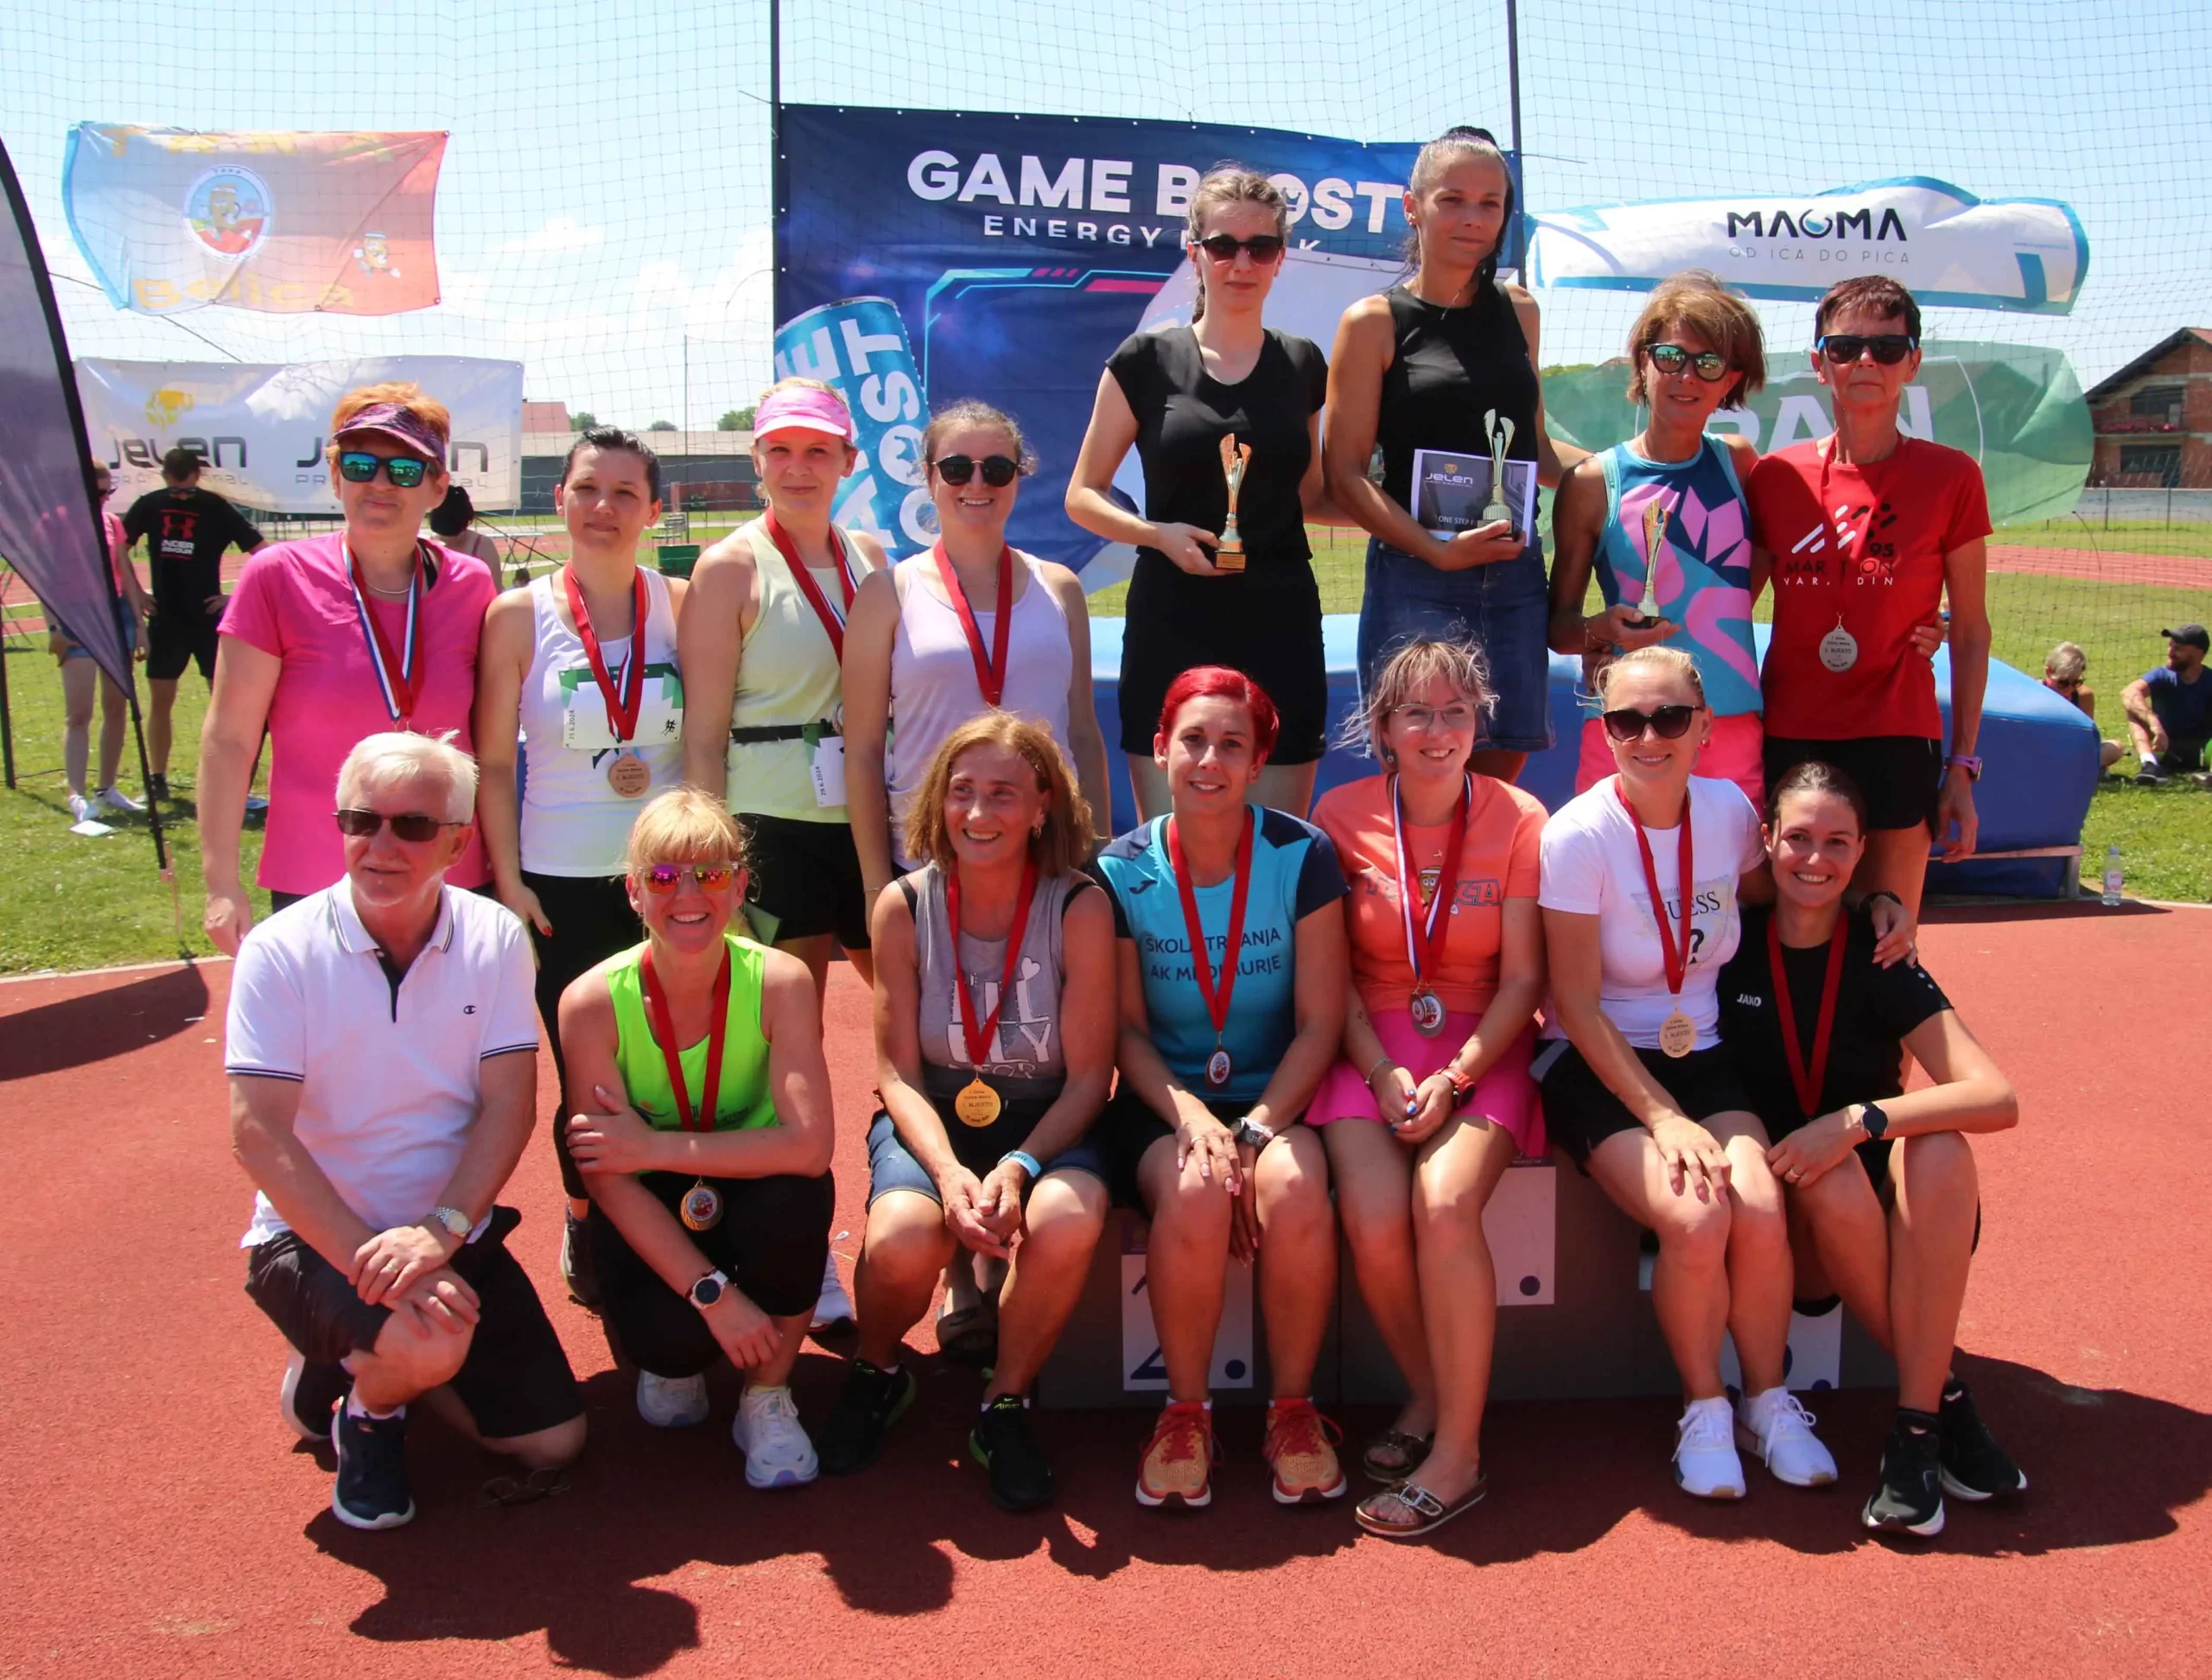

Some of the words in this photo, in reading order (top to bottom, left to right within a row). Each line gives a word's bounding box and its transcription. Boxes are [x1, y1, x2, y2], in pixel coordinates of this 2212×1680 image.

[907, 150, 1134, 214] GAME
[1156, 162, 1404, 234] BOST
[983, 214, 1163, 249] ENERGY
[1726, 207, 1908, 241] MAGMA
[1729, 246, 1758, 259] OD
[1819, 248, 1848, 263] DO
[1438, 515, 1453, 524] ONE
[1869, 542, 1895, 558] 95
[1785, 559, 1895, 576] MARTON
[1783, 576, 1894, 586] VARDIN
[1663, 890, 1720, 920] USS
[1145, 934, 1193, 954] ŠKOL
[1205, 927, 1282, 951] TRANJA
[1150, 964, 1171, 982] AK
[1176, 954, 1282, 982] MIURJE
[1736, 992, 1763, 1008] JAKO
